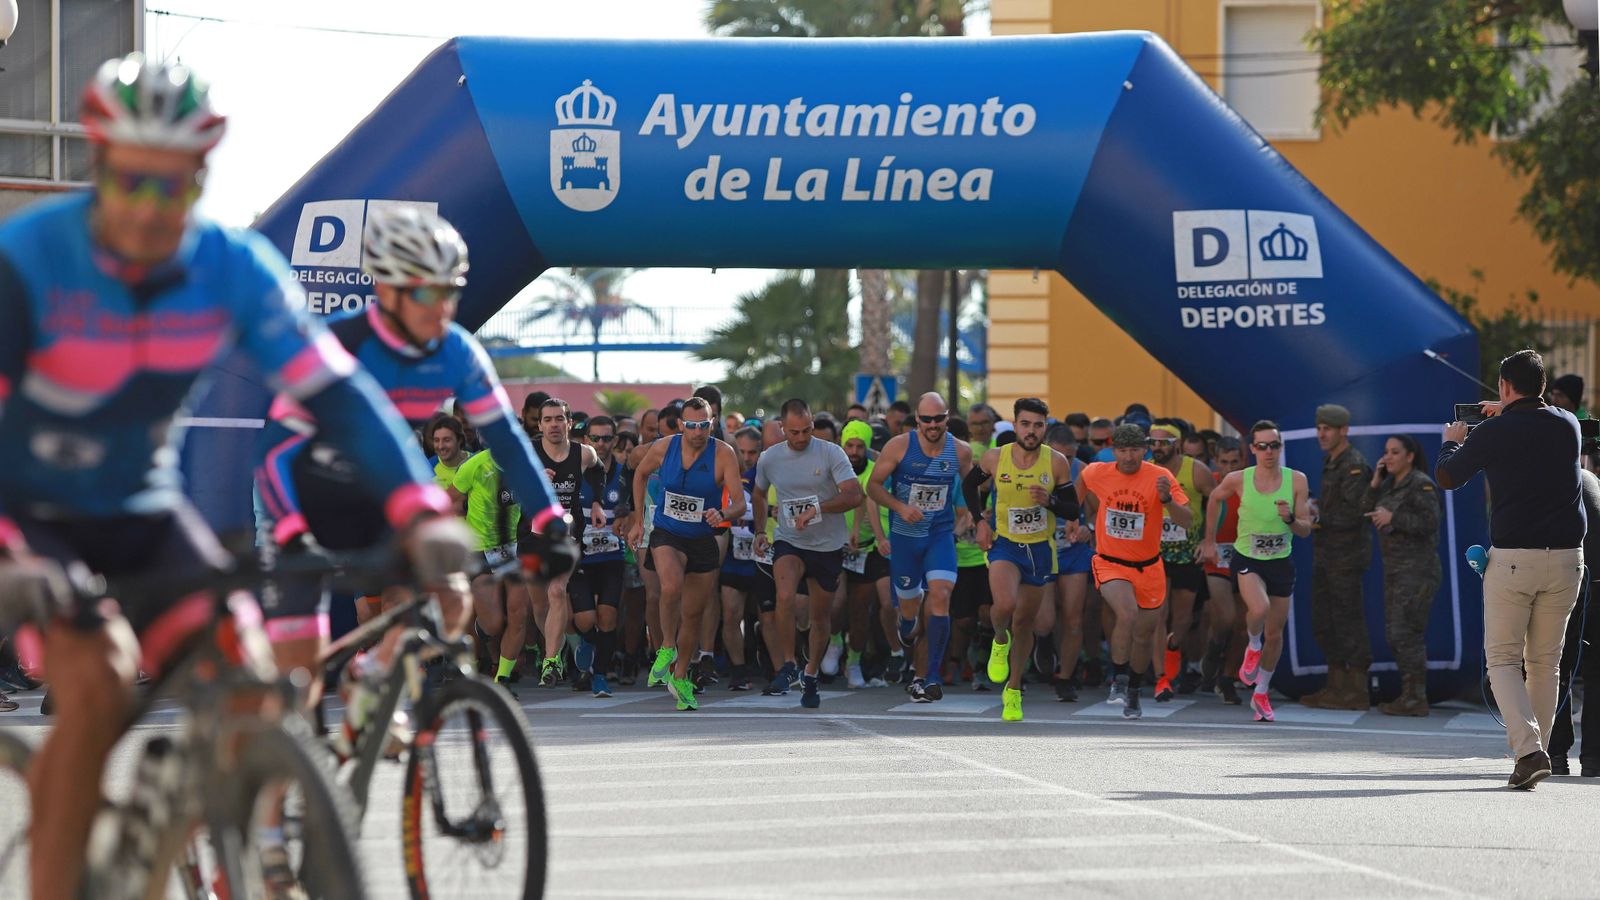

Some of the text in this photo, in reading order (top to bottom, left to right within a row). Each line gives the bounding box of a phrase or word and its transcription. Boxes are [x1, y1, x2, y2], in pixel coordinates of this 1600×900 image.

[639, 92, 1037, 150] Ayuntamiento
[684, 155, 994, 201] de La Línea
[309, 215, 346, 253] D
[1192, 226, 1230, 268] D
[288, 269, 376, 285] DELEGACIÓ
[1177, 281, 1298, 299] DELEGACIÓN DE
[1180, 302, 1326, 329] DEPORTES
[917, 490, 940, 502] 171
[670, 499, 698, 512] 280
[1014, 510, 1042, 524] 305
[1111, 516, 1136, 530] 191
[1162, 522, 1178, 532] 07
[592, 536, 609, 546] 96
[738, 541, 753, 550] 17
[1256, 538, 1283, 548] 242
